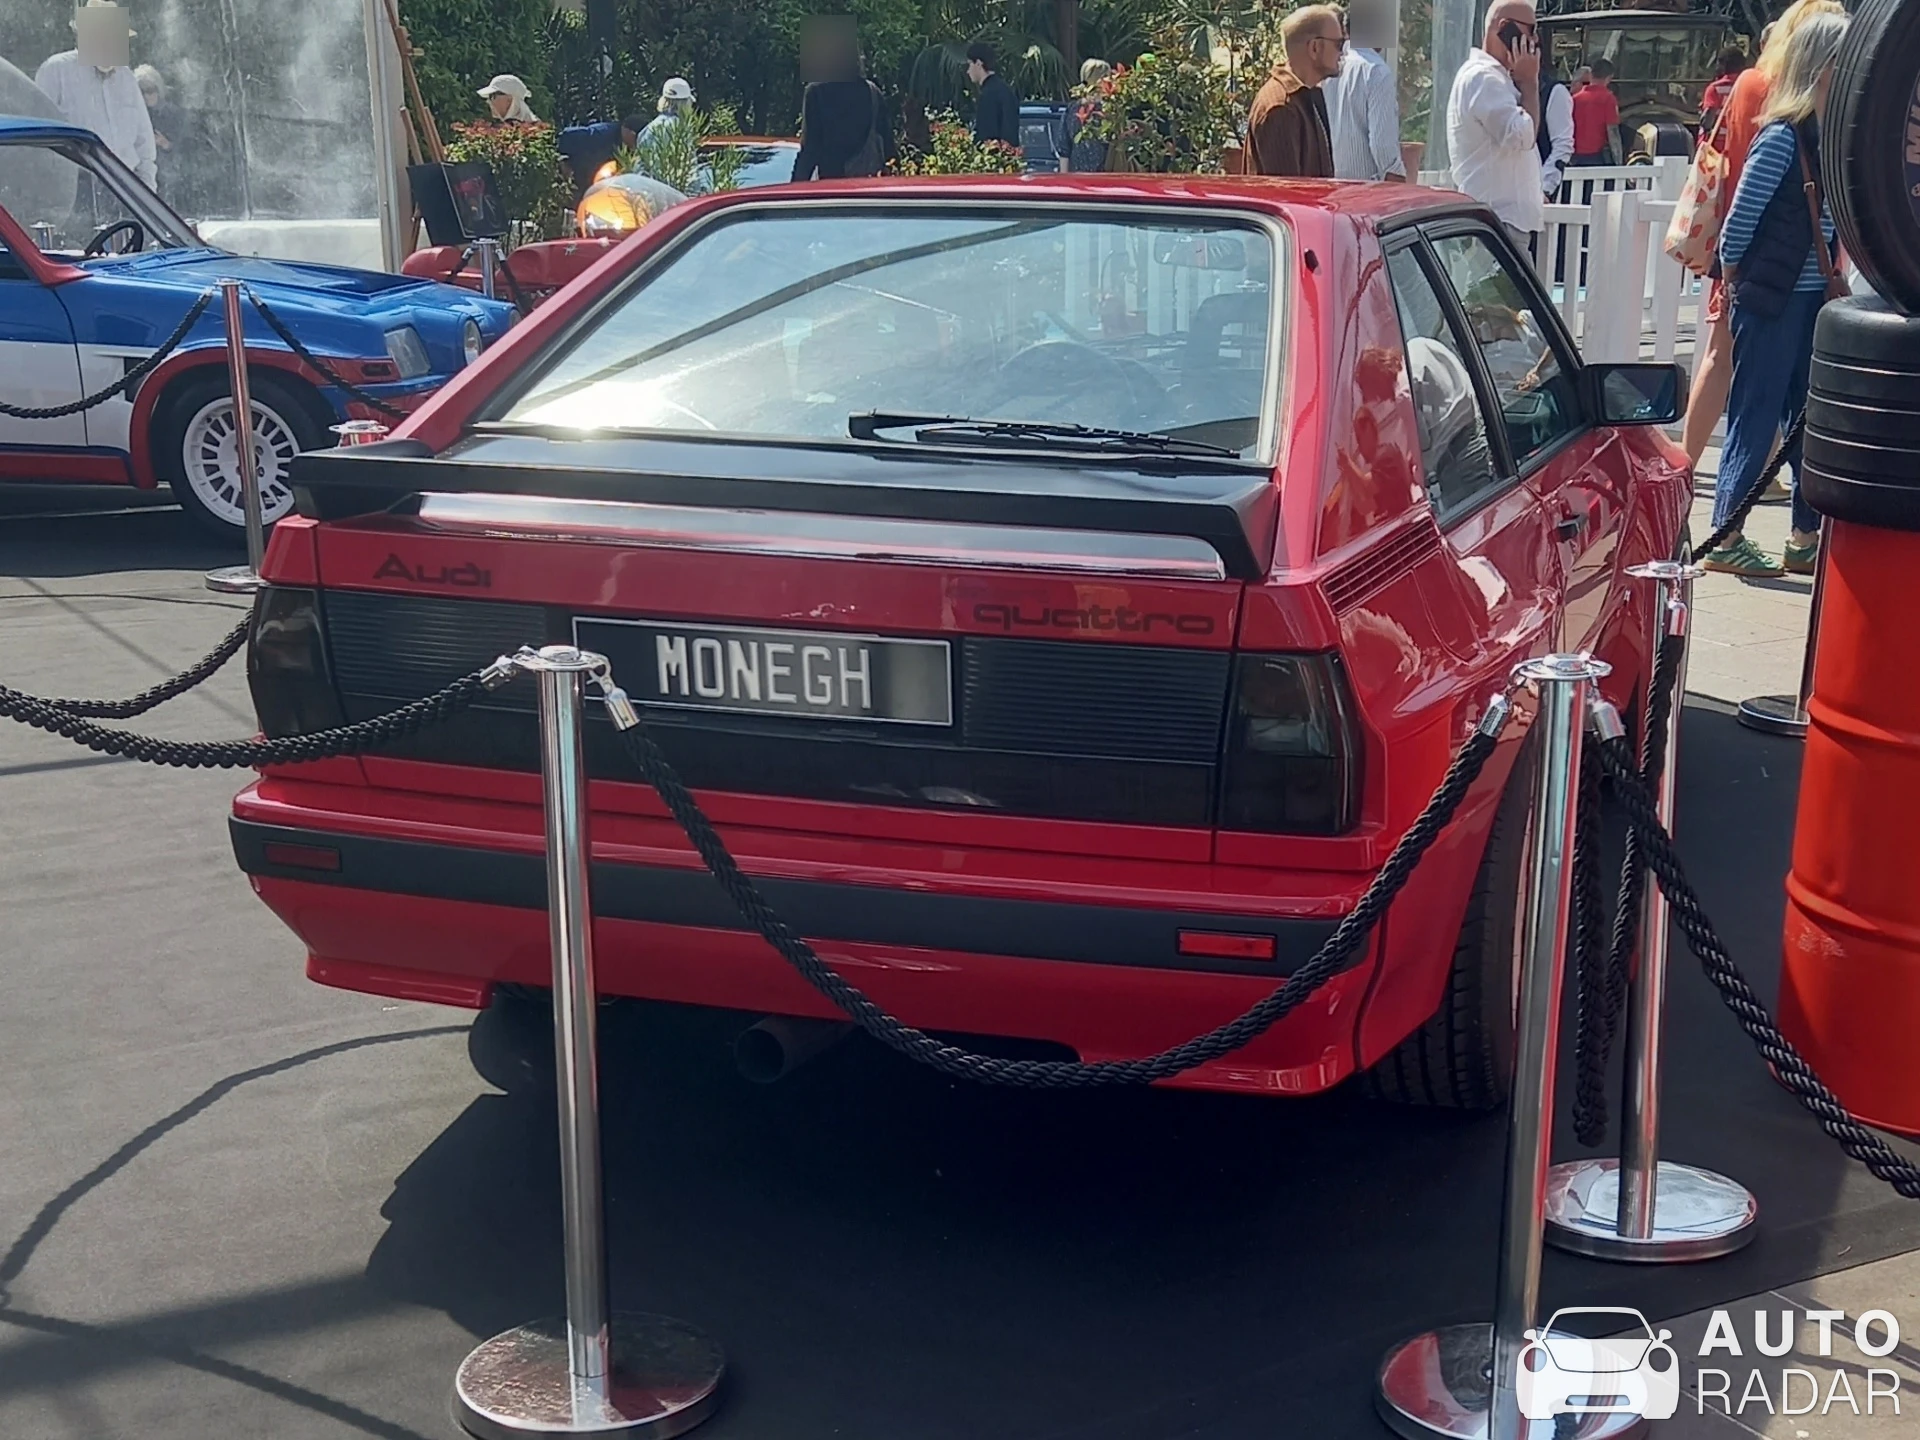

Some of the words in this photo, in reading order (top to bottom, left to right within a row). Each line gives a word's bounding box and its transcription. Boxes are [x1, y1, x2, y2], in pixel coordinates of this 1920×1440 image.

[373, 553, 492, 588] Audi
[973, 603, 1215, 636] quattro
[655, 634, 872, 709] MONEGH
